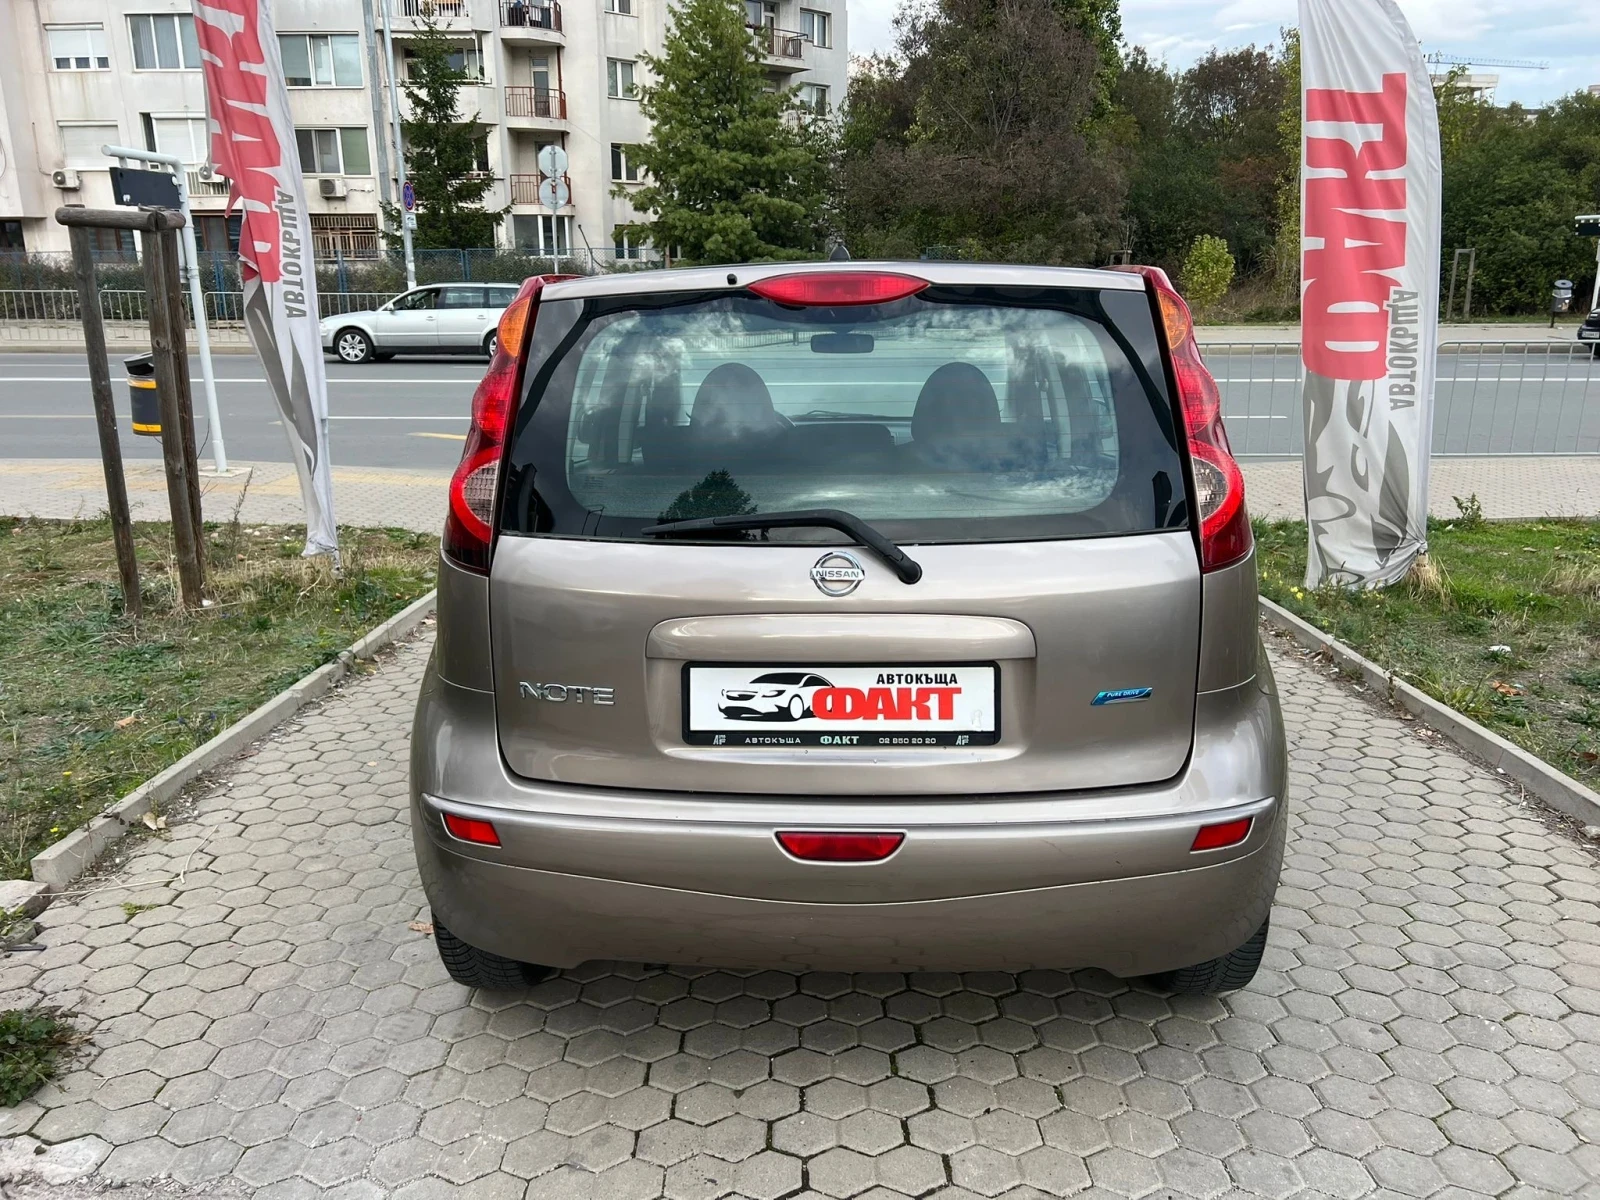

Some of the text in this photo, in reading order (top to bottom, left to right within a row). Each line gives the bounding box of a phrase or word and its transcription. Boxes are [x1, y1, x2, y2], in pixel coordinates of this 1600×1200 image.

[815, 570, 860, 578] NISSAN
[876, 673, 958, 686] АВТОКЪЩА
[519, 681, 616, 706] NOTE
[812, 687, 962, 720] ФАКТ
[819, 735, 860, 745] ФАКТ
